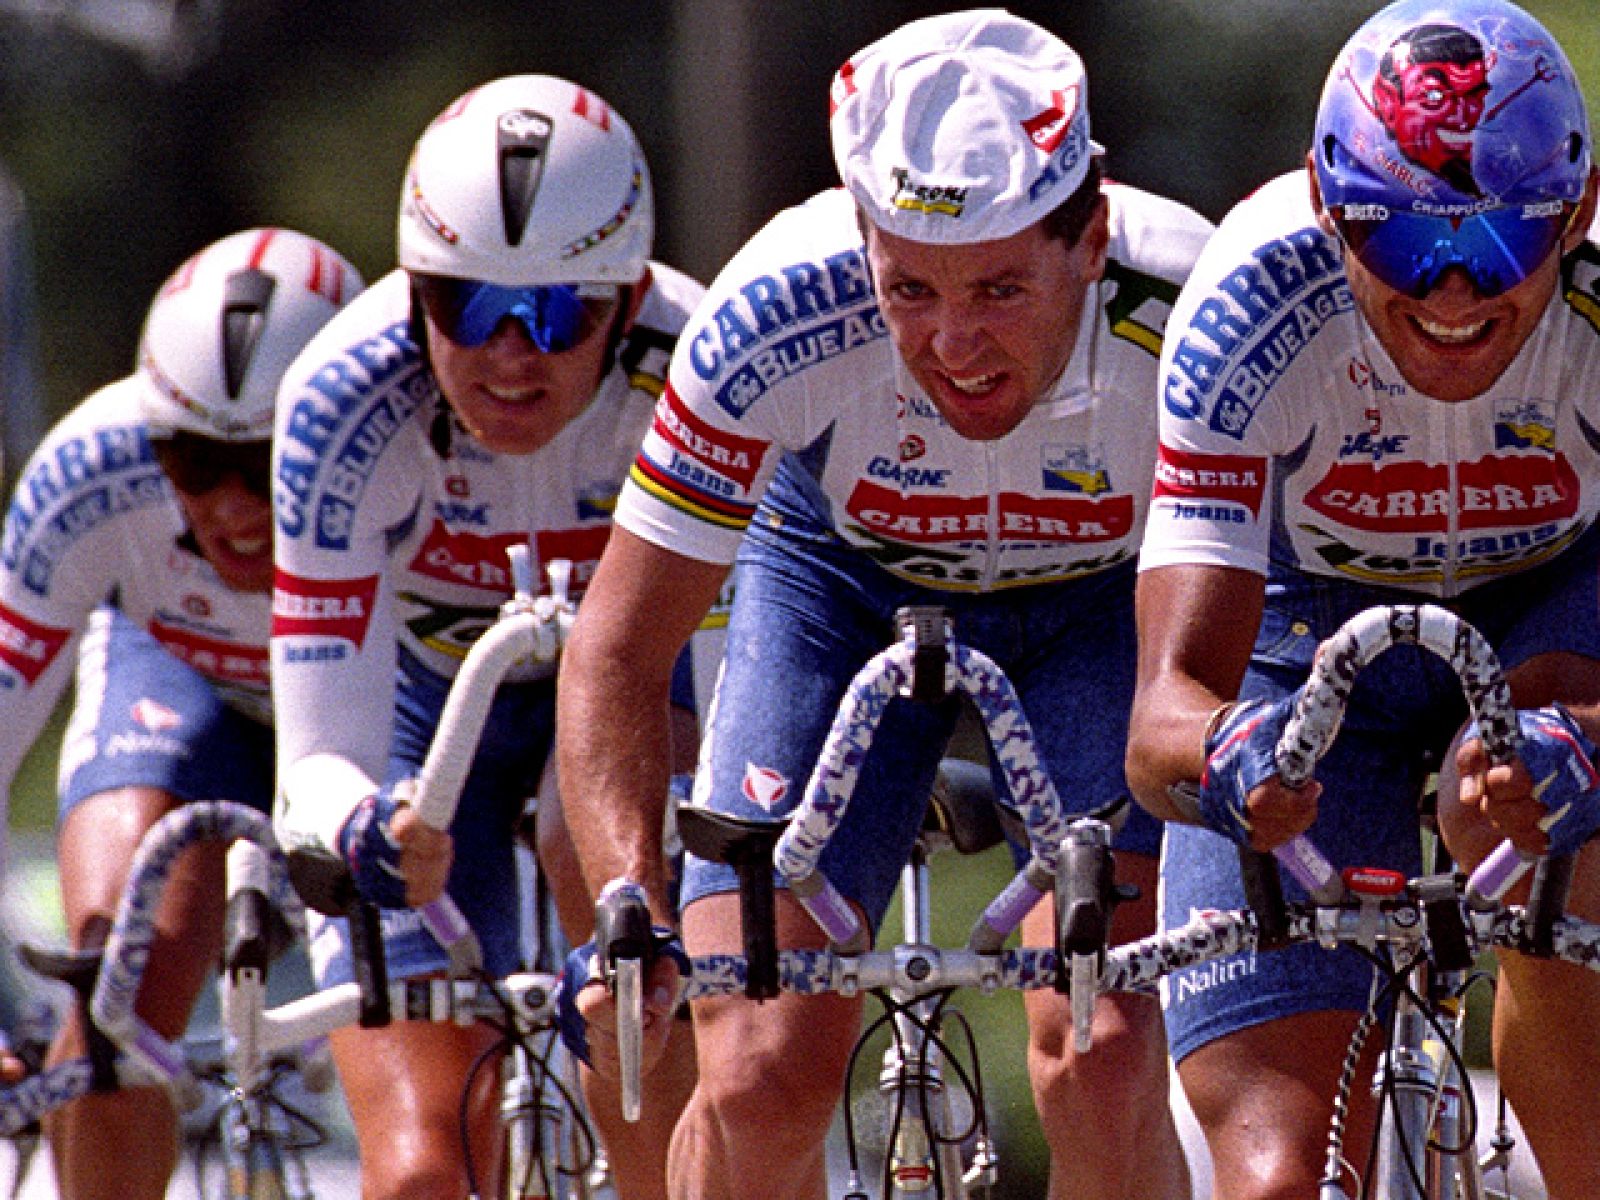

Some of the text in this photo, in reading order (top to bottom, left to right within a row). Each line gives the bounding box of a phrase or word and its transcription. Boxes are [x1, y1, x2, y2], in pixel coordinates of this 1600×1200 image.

[1320, 484, 1566, 518] CARRERA
[858, 509, 1110, 537] CARRERA
[1178, 950, 1257, 1002] Nalini
